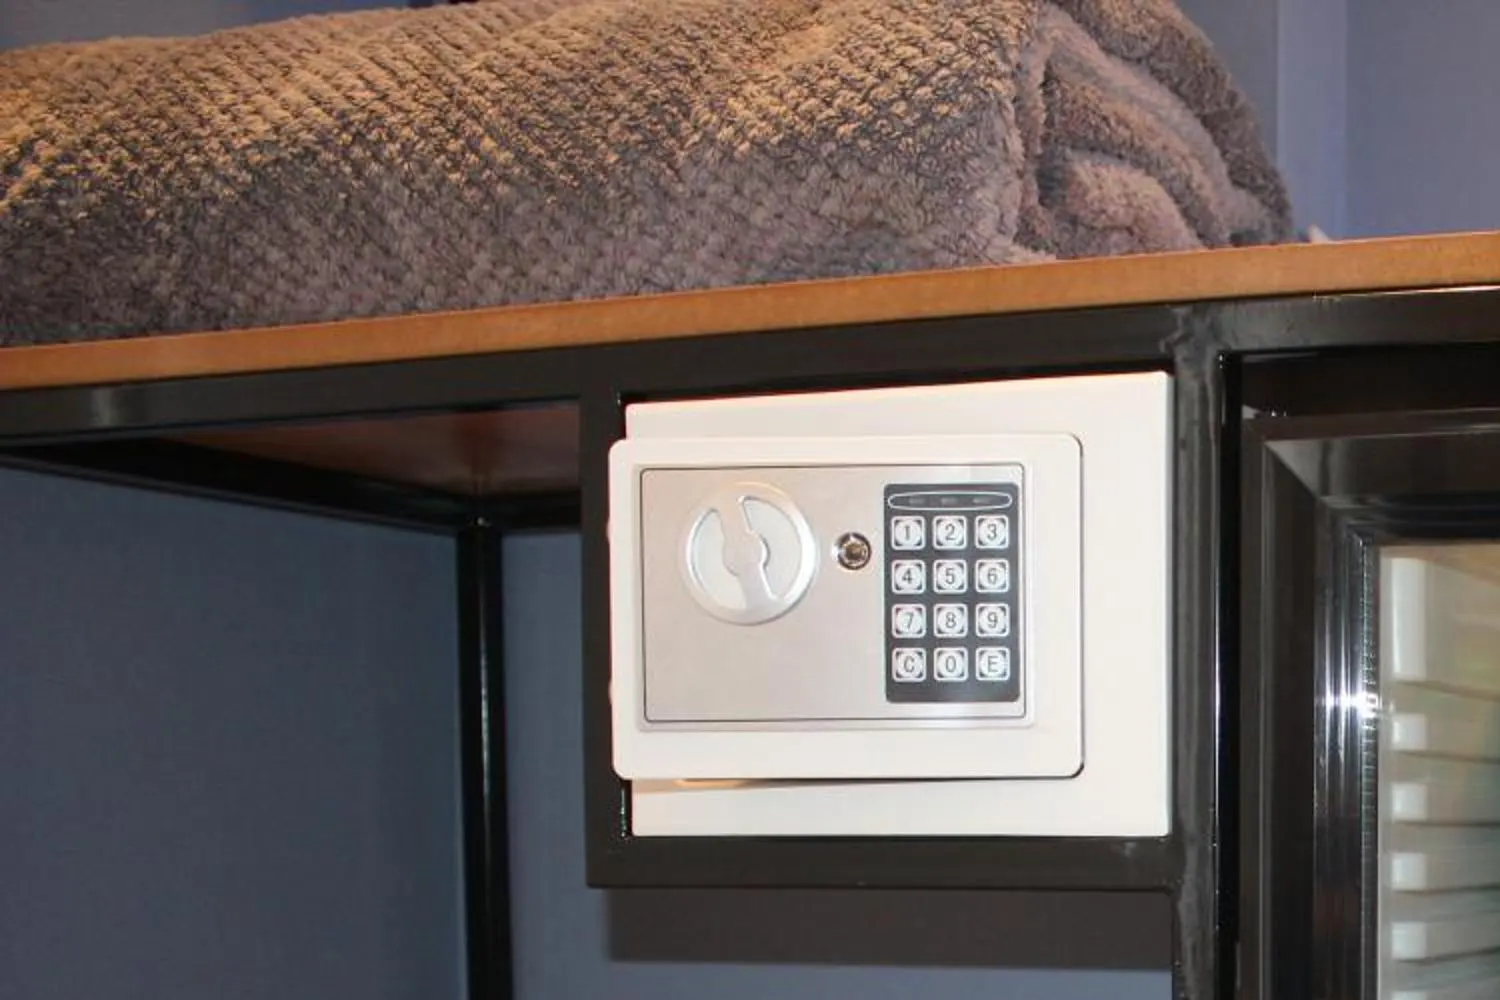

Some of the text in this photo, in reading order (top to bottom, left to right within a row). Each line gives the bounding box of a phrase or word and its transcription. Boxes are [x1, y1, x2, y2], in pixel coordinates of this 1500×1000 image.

[903, 523, 998, 541] 1 2 3
[901, 567, 999, 585] 4 5 6
[901, 611, 999, 630] 7 8 9
[903, 655, 916, 673] C
[986, 655, 999, 673] E
